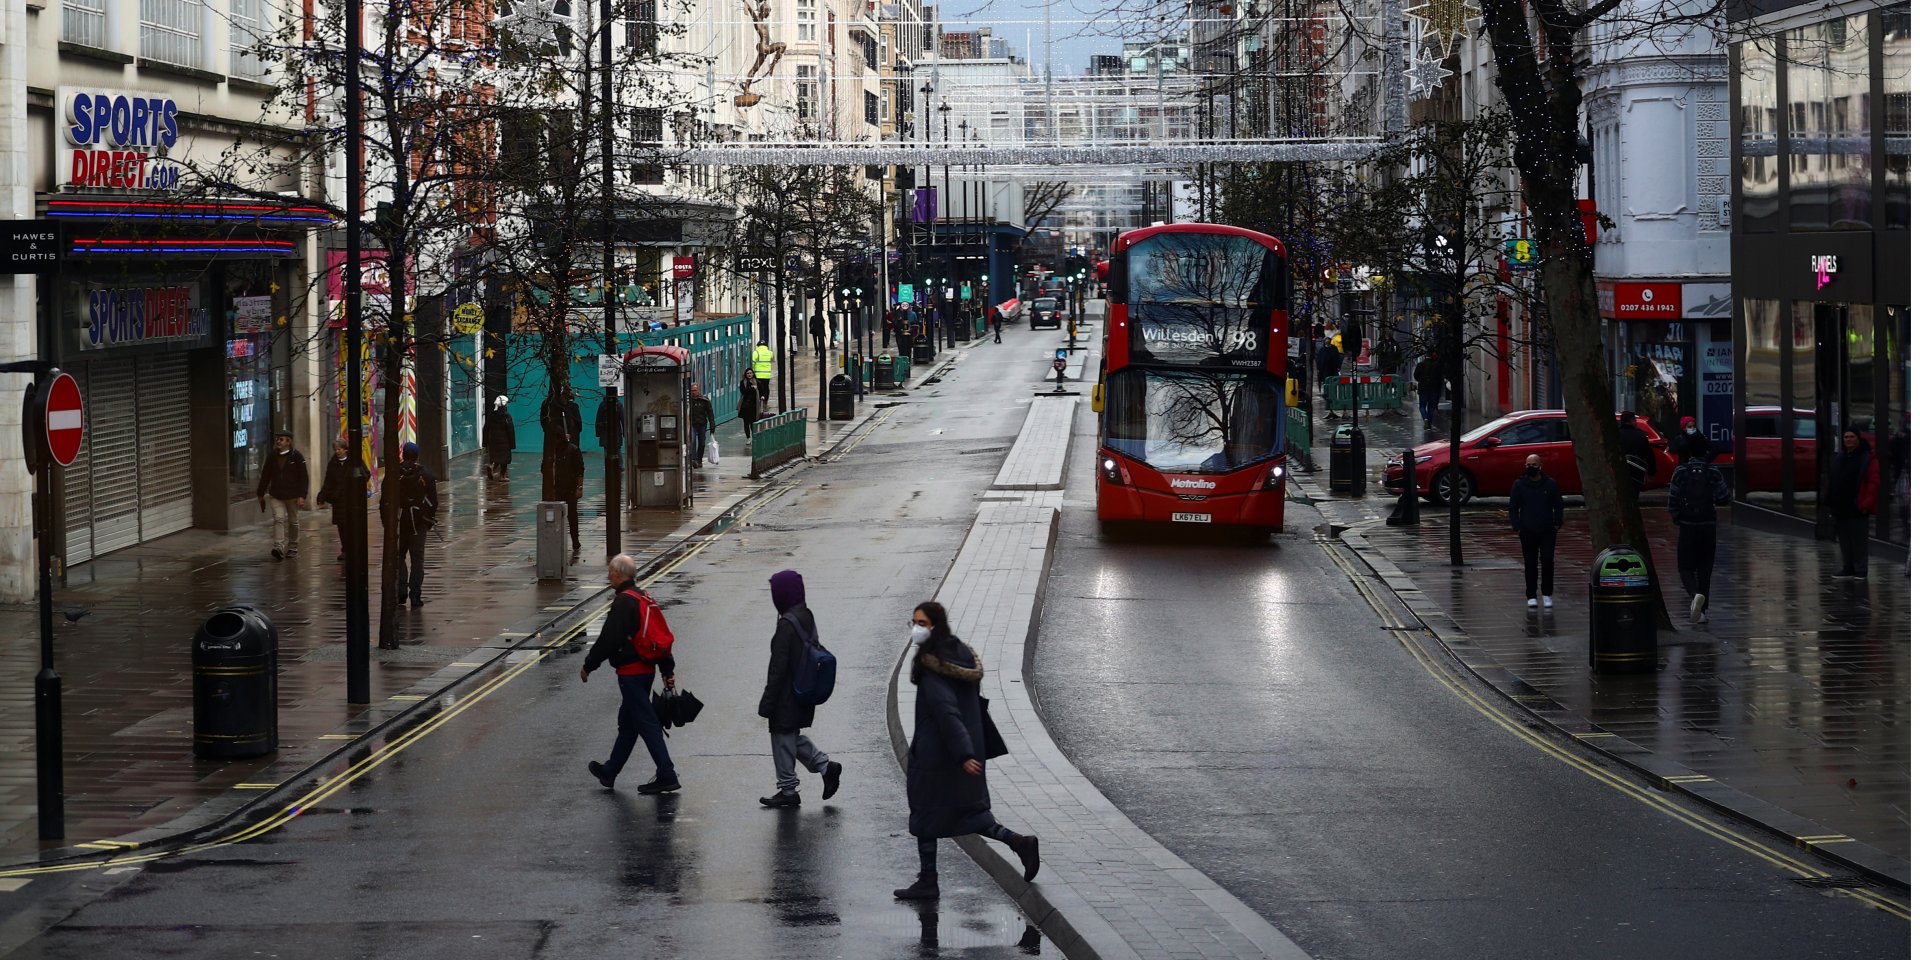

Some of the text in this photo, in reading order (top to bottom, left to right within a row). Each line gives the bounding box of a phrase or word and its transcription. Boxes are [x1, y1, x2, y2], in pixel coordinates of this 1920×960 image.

[69, 92, 179, 149] SPORTS
[13, 233, 55, 241] HAWES
[29, 242, 38, 250] &
[12, 252, 56, 261] CURTIS
[740, 257, 777, 270] next
[1620, 304, 1675, 312] 0207 436 1942
[1142, 327, 1257, 351] Willesden 98
[1707, 382, 1732, 393] 0207
[1171, 478, 1216, 490] Metroline
[1174, 513, 1209, 522] LK67 ELJ
